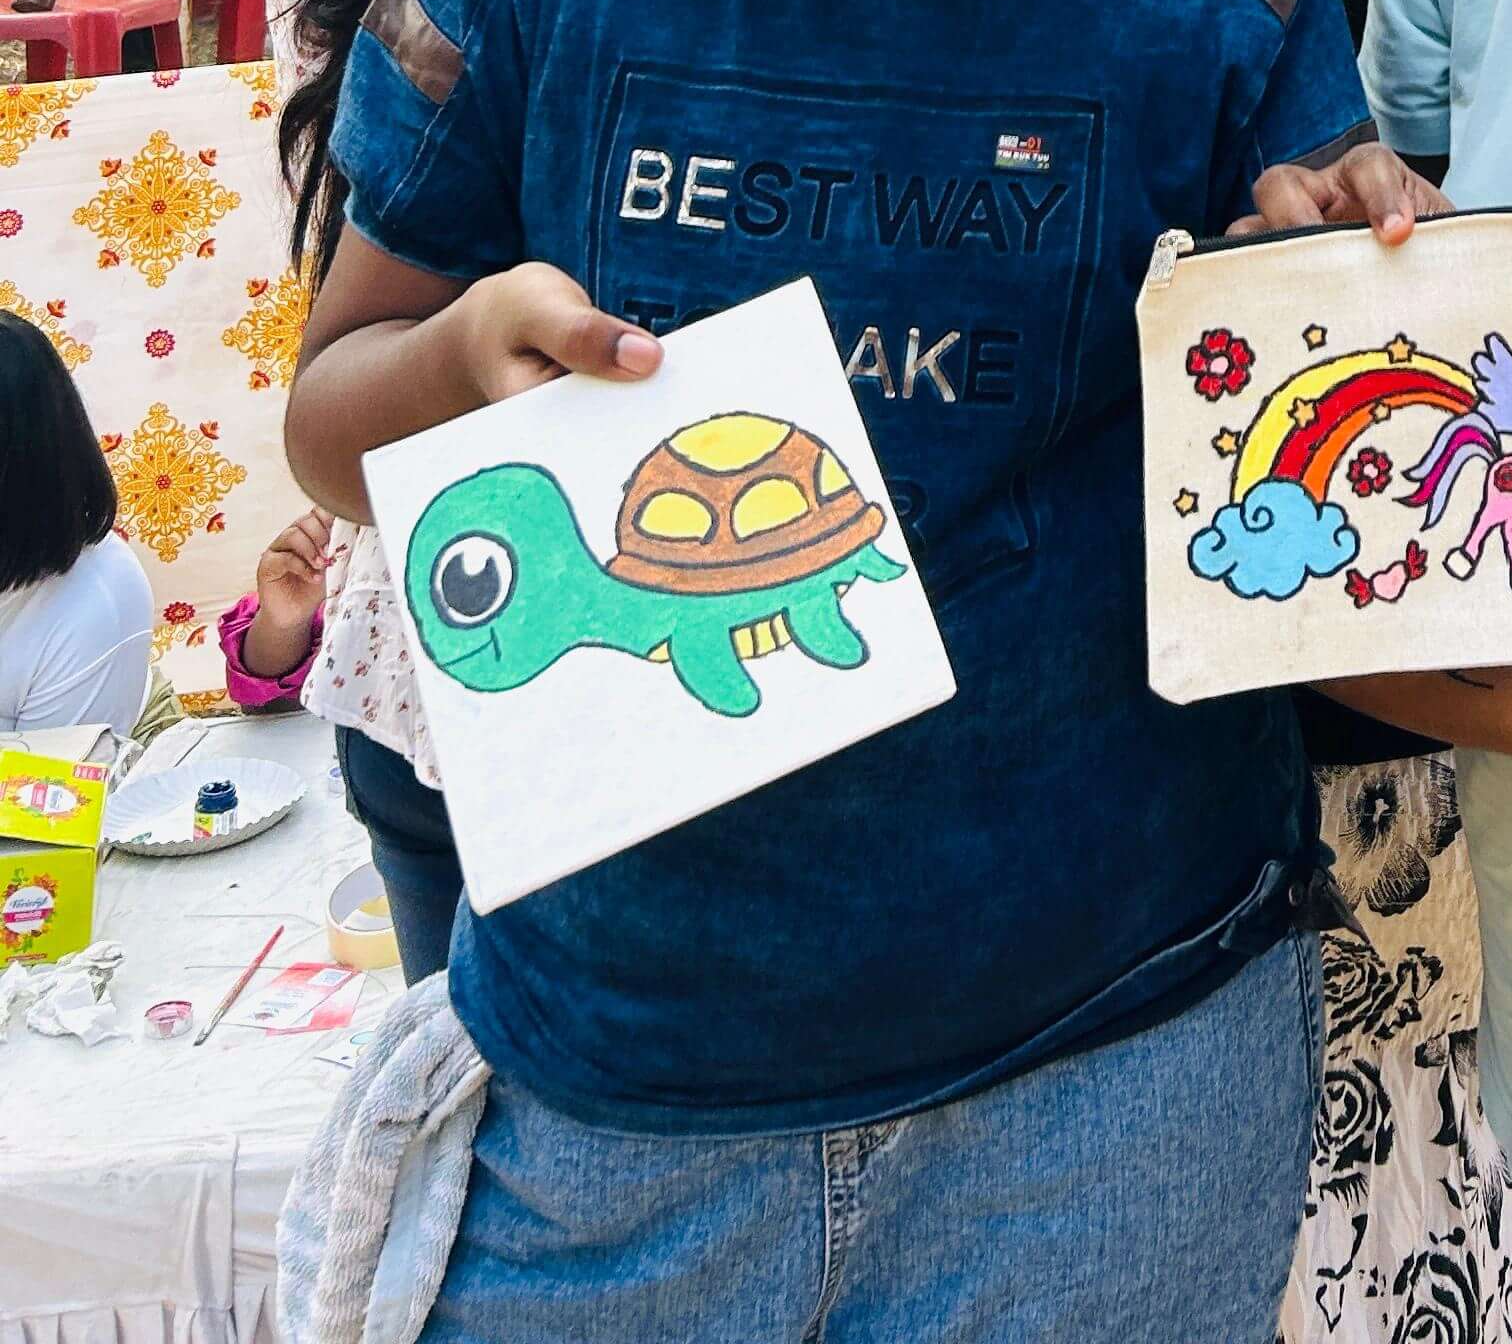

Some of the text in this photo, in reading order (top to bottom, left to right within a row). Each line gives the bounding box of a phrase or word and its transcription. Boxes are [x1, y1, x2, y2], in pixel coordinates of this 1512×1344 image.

[618, 148, 1070, 255] BEST WAY
[845, 325, 1024, 404] AKE
